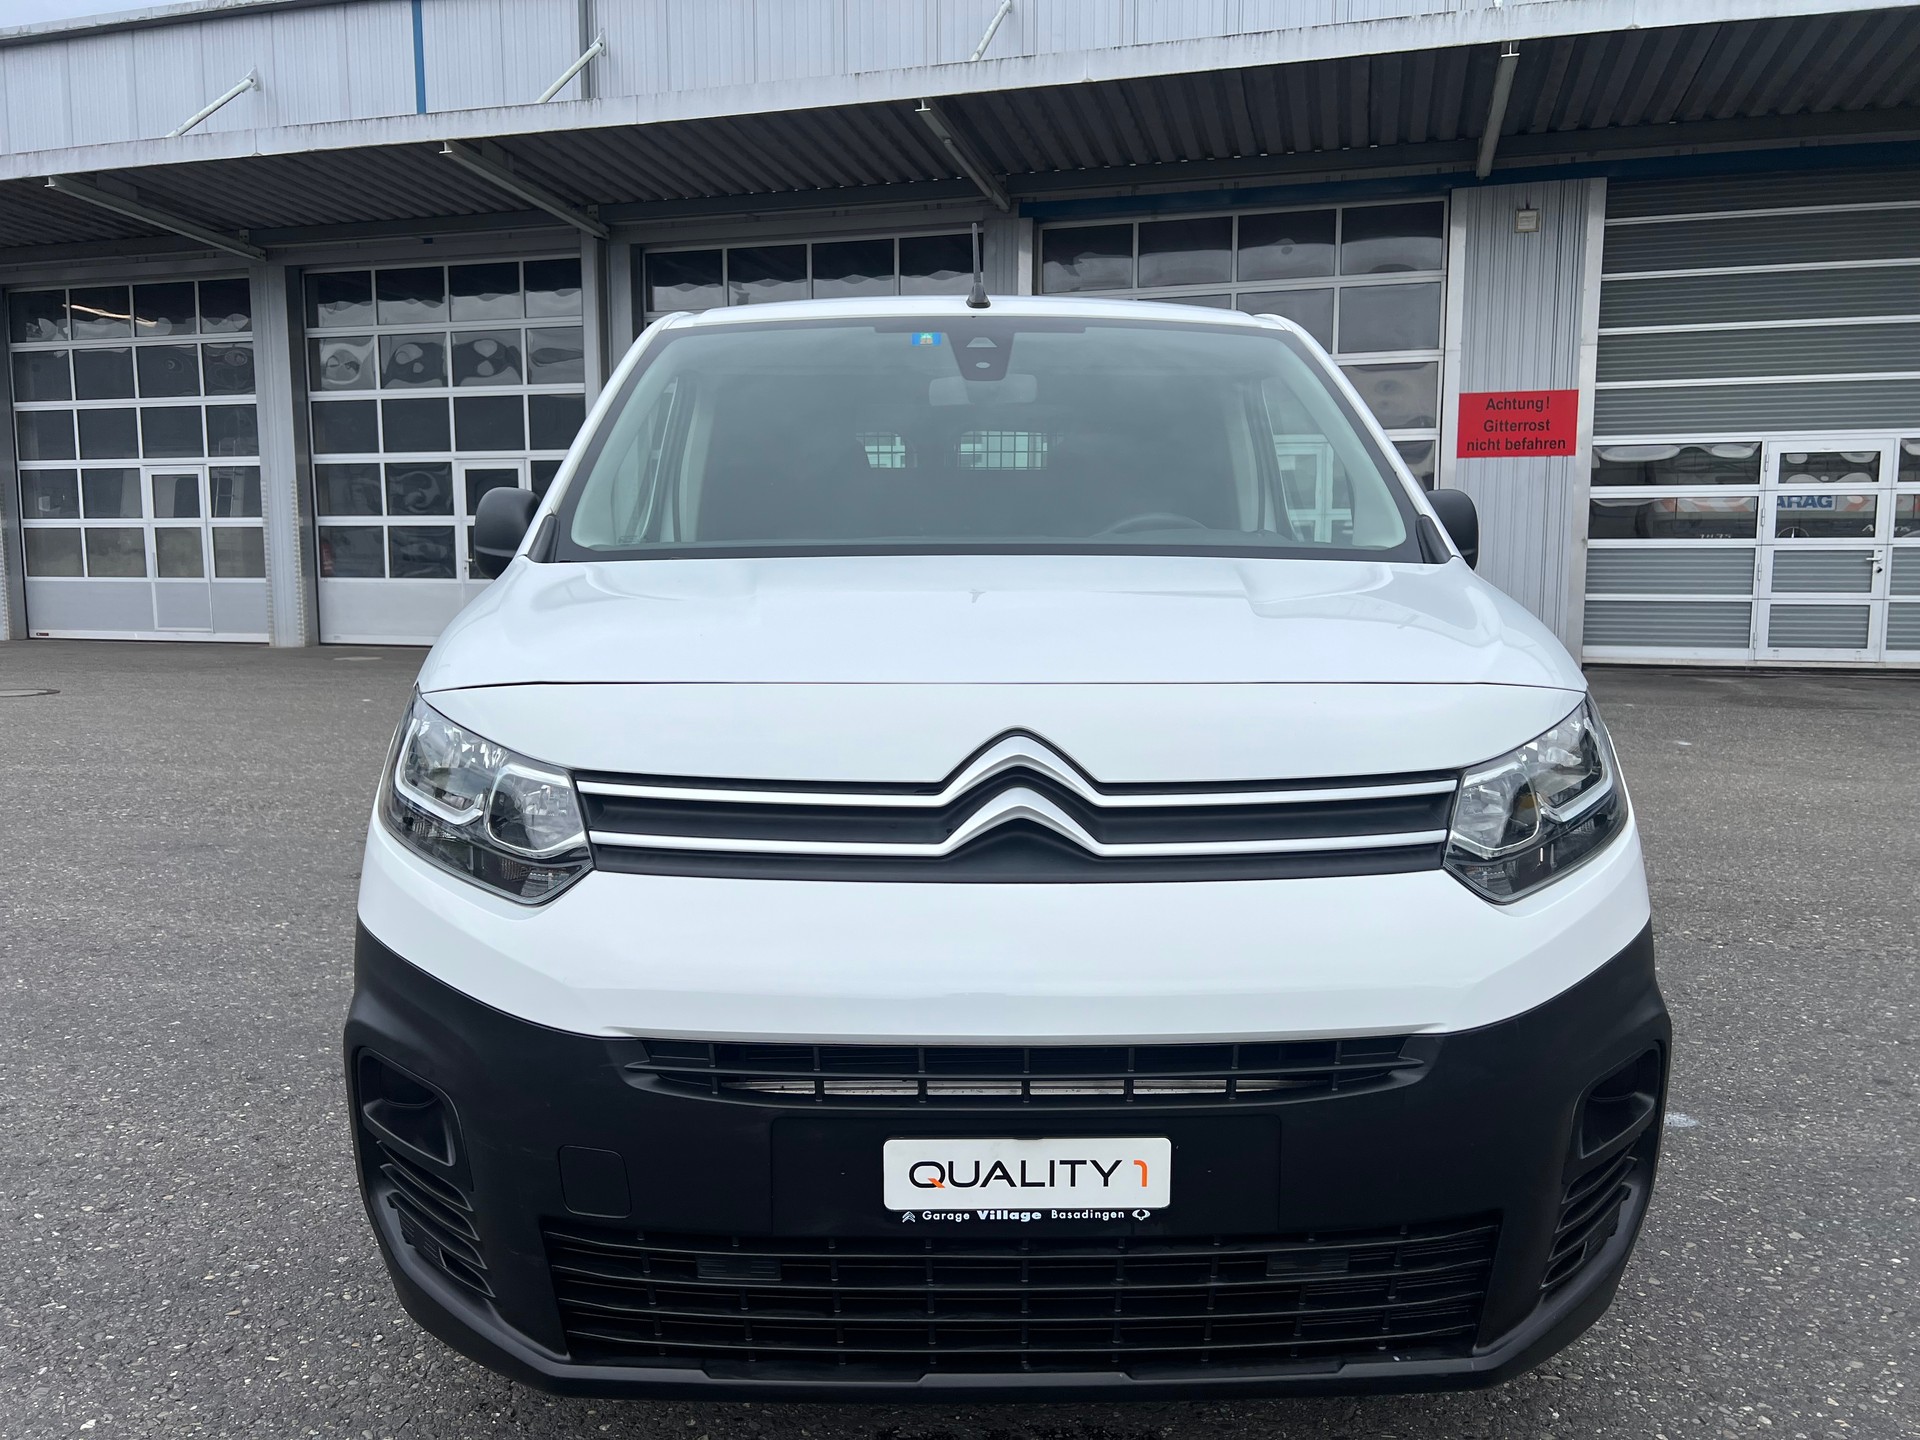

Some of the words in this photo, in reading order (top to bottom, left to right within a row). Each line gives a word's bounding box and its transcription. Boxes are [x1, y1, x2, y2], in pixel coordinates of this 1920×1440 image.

[1483, 419, 1551, 432] Gitterrost
[1467, 438, 1501, 451] nicht
[1504, 437, 1566, 451] befahren
[908, 1160, 1123, 1188] QUALITY
[1133, 1160, 1148, 1187] 1
[922, 1211, 970, 1221] Garage
[976, 1210, 1042, 1221] Village
[1051, 1210, 1125, 1221] Basadingen
